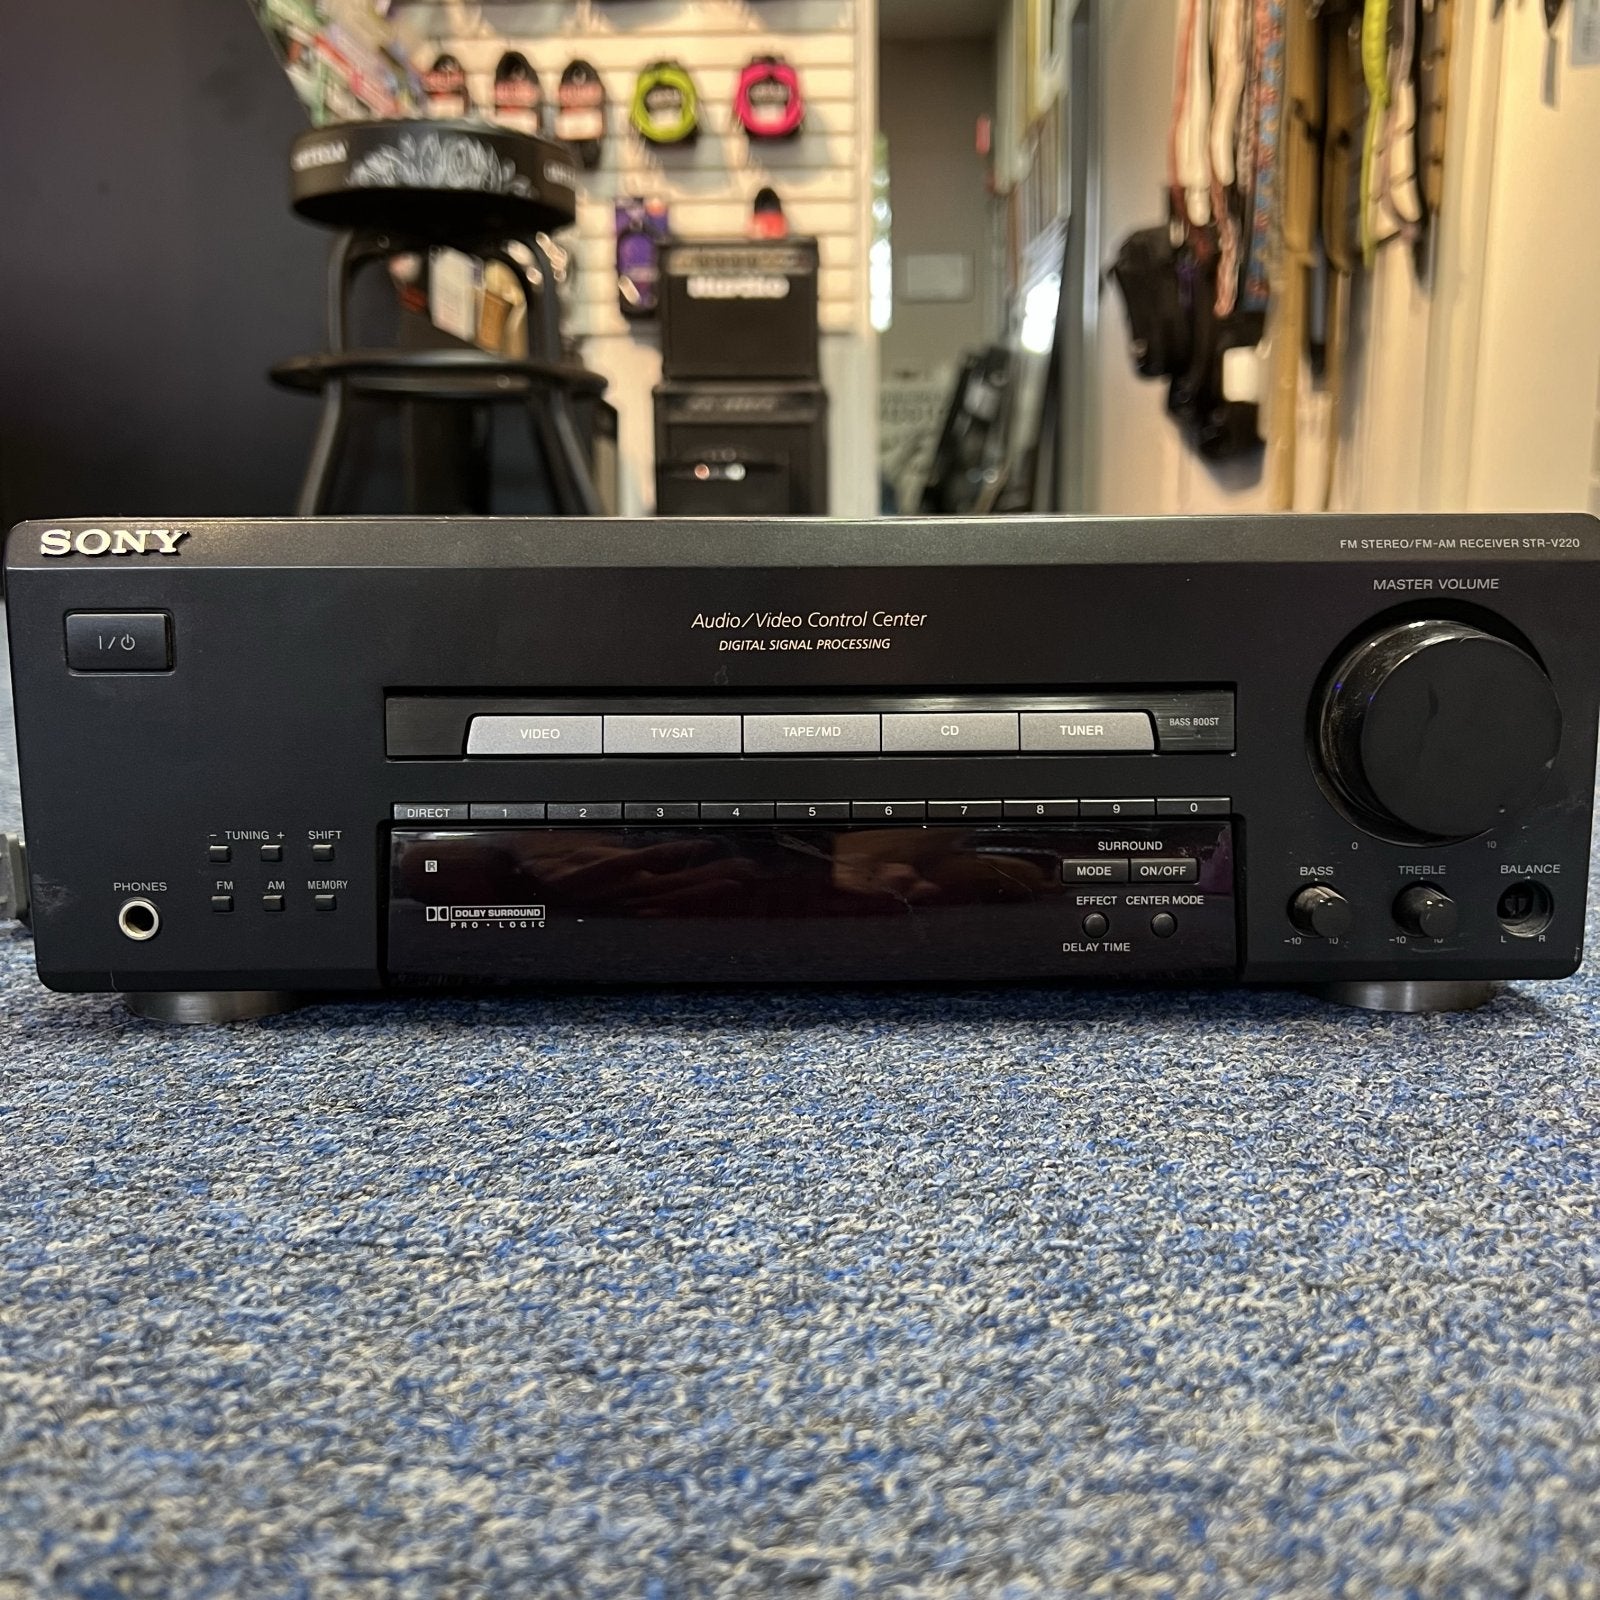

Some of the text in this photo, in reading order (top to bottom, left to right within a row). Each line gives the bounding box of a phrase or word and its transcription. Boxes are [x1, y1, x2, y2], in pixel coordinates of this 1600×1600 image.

[40, 529, 189, 556] SONY
[1339, 538, 1580, 549] FM STEREO/FM-AM RECEIVER STR-V220
[1373, 578, 1500, 591] MASTER VOLUME
[807, 610, 868, 628] Control
[872, 611, 928, 627] Center
[718, 638, 891, 651] DIGITAL SIGNAL PROCESSING
[1169, 717, 1220, 727] BASS BOOST
[520, 729, 560, 739] VIDEO
[650, 727, 695, 739] TV/SAT
[783, 727, 841, 737] TAPE/MD
[941, 725, 959, 736] CD
[1060, 725, 1104, 736] TUNER
[407, 808, 451, 818] DIRECT
[501, 808, 508, 818] 1
[579, 807, 587, 818] 2
[656, 807, 664, 818] 3
[732, 807, 740, 817] 4
[808, 806, 817, 817] 5
[884, 805, 893, 816] 6
[960, 805, 968, 815] 7
[1036, 804, 1045, 815] 8
[1112, 803, 1121, 814] 9
[1189, 802, 1198, 813] 0
[224, 830, 270, 840] TUNING
[308, 830, 342, 840] SHIFT
[1097, 840, 1163, 851] SURROUND
[1351, 841, 1359, 850] 0
[1486, 840, 1497, 849] 10
[1076, 866, 1112, 877] MODE
[1140, 865, 1187, 876] ON/OFF
[1299, 865, 1334, 876] BASS
[1397, 864, 1447, 875] TREBLE
[1500, 863, 1561, 874] BALANCE
[113, 881, 168, 892] PHONES
[216, 880, 234, 890] FM
[267, 880, 286, 890] AM
[307, 880, 348, 890] MEMORY
[1076, 895, 1118, 906] EFFECT
[1125, 895, 1204, 906] CENTER MODE
[454, 908, 541, 918] DOLBY SURROUND
[1283, 936, 1302, 945] -10
[1388, 935, 1407, 944] -10
[1500, 935, 1507, 944] L
[1538, 934, 1546, 943] R
[1062, 942, 1131, 952] DELAY TIME
